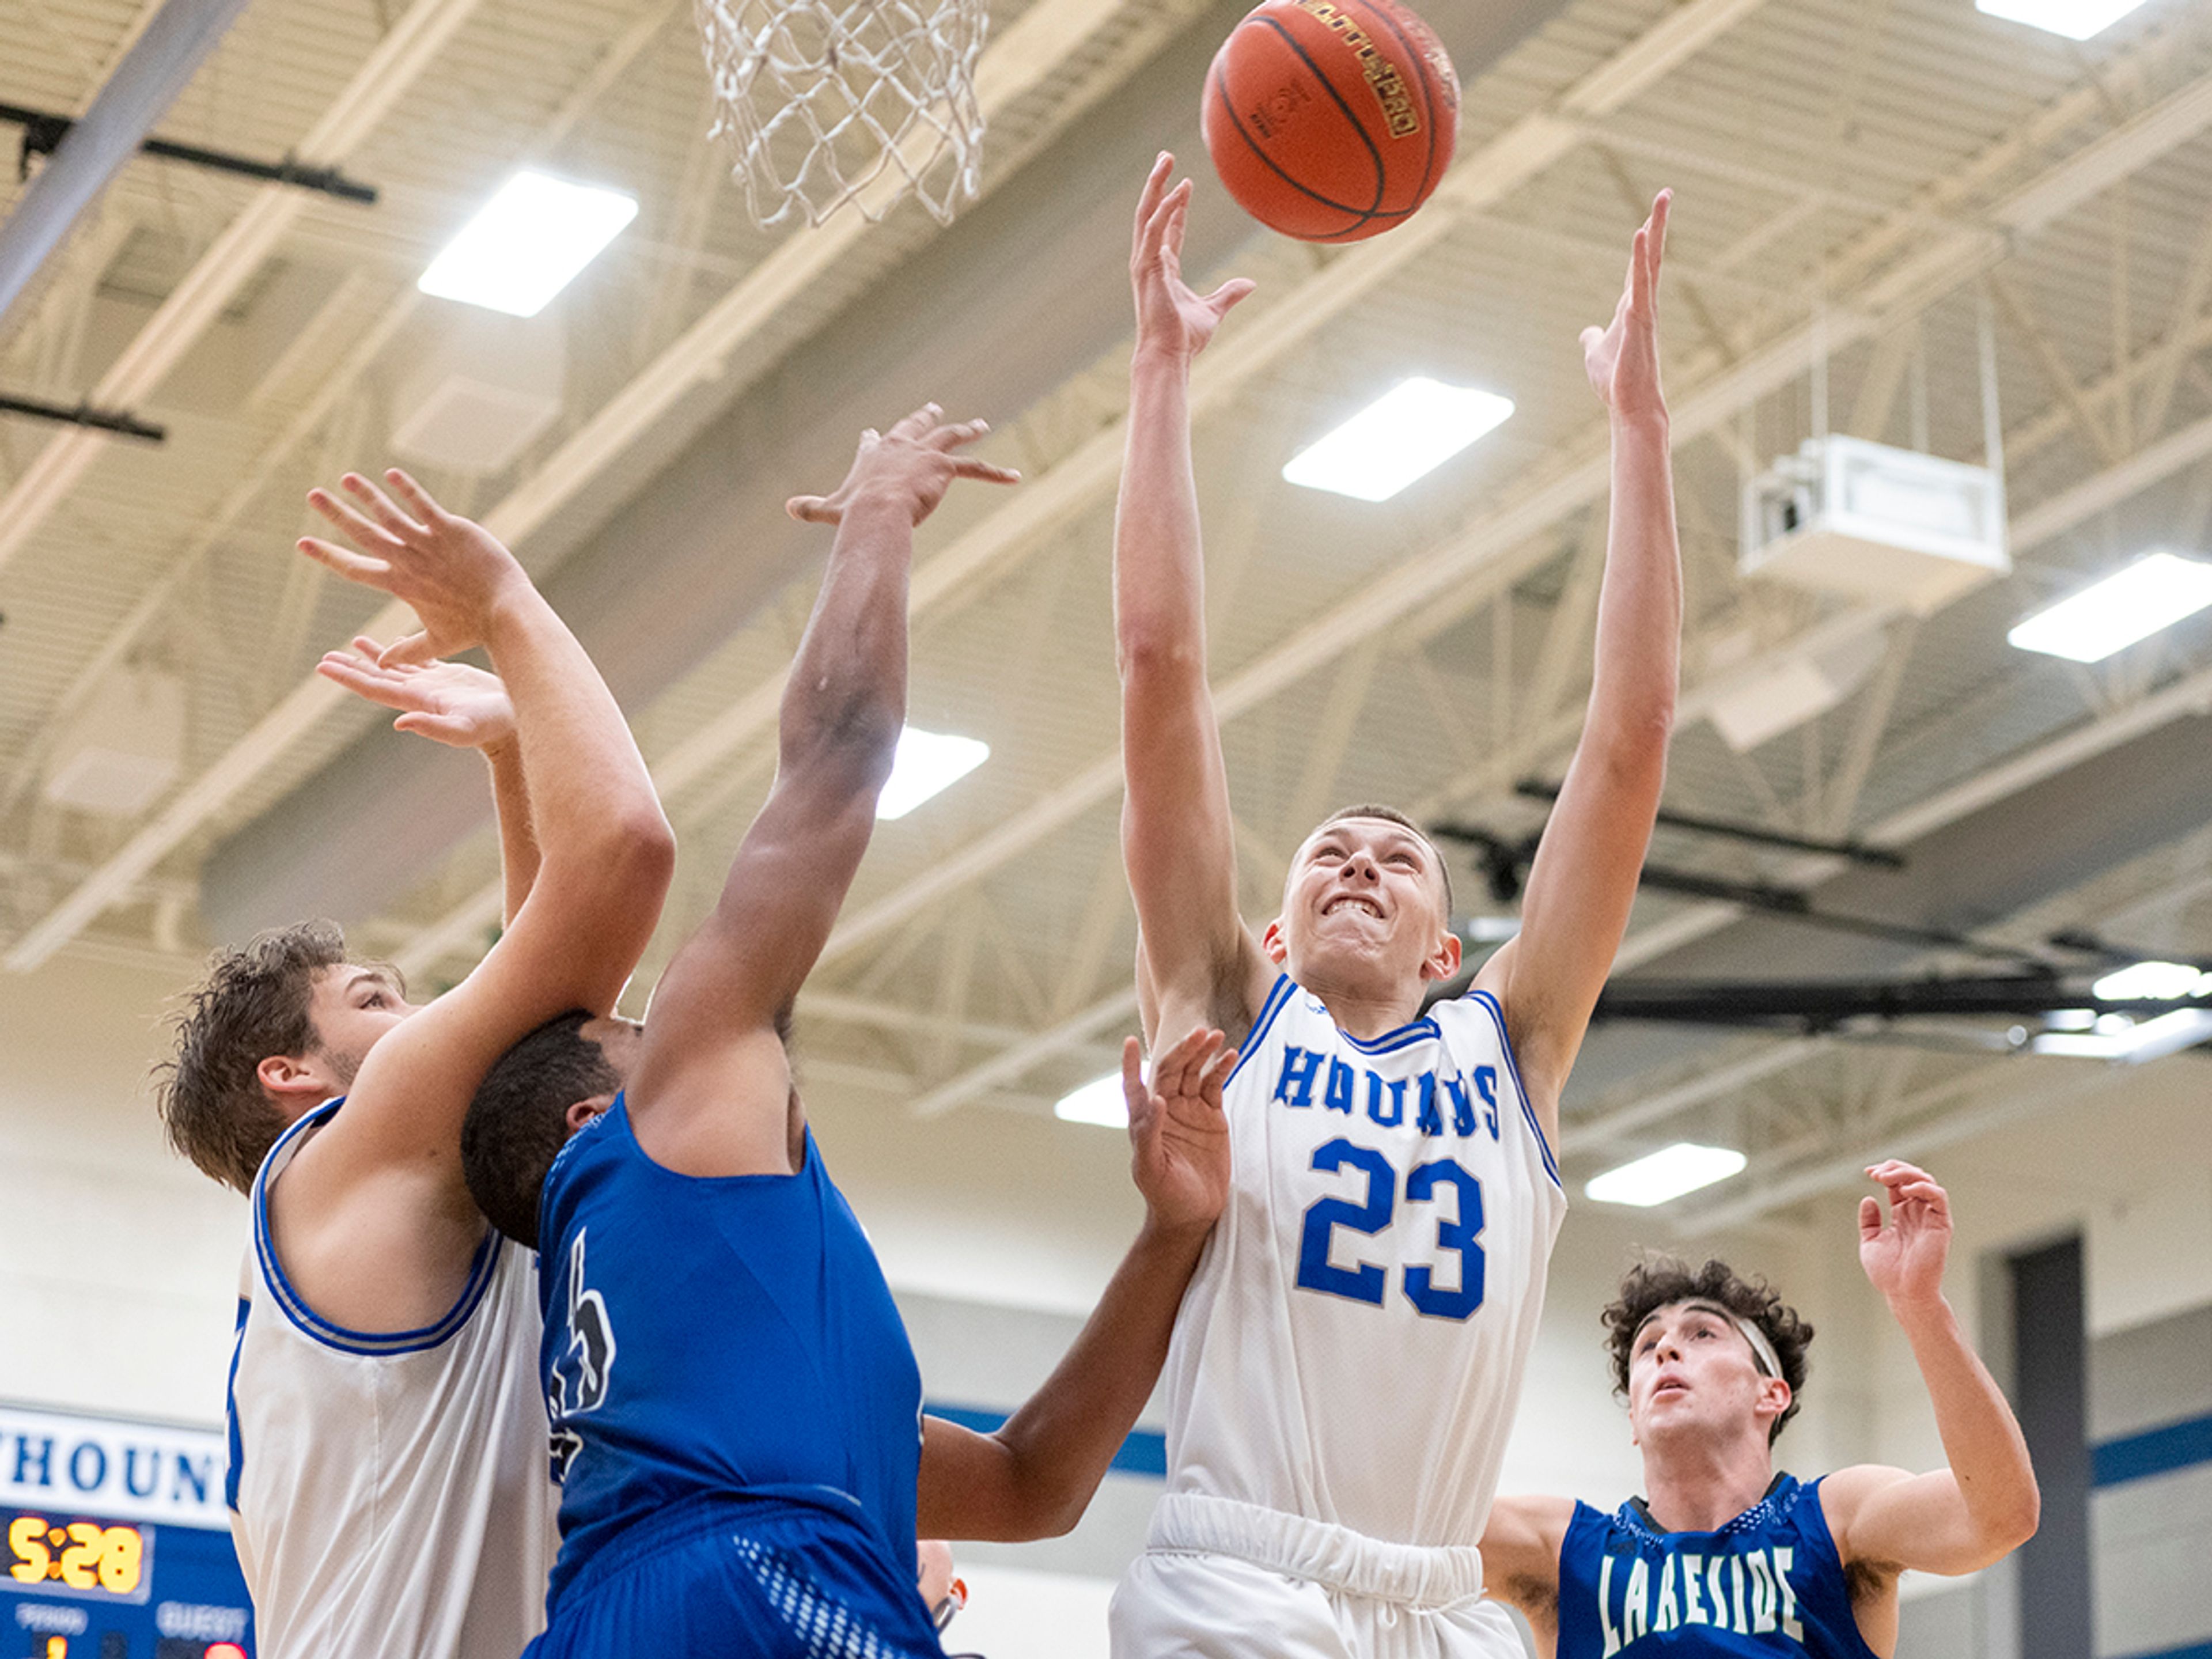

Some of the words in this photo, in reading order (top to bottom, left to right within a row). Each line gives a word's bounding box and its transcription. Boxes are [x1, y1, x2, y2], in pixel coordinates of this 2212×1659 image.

[1271, 1044, 1499, 1142] HOUNDS
[1294, 1137, 1485, 1323] 23
[0, 1434, 212, 1503] HOUN
[9, 1516, 143, 1594] 5:28
[1599, 1547, 1804, 1659] LAKESIDE
